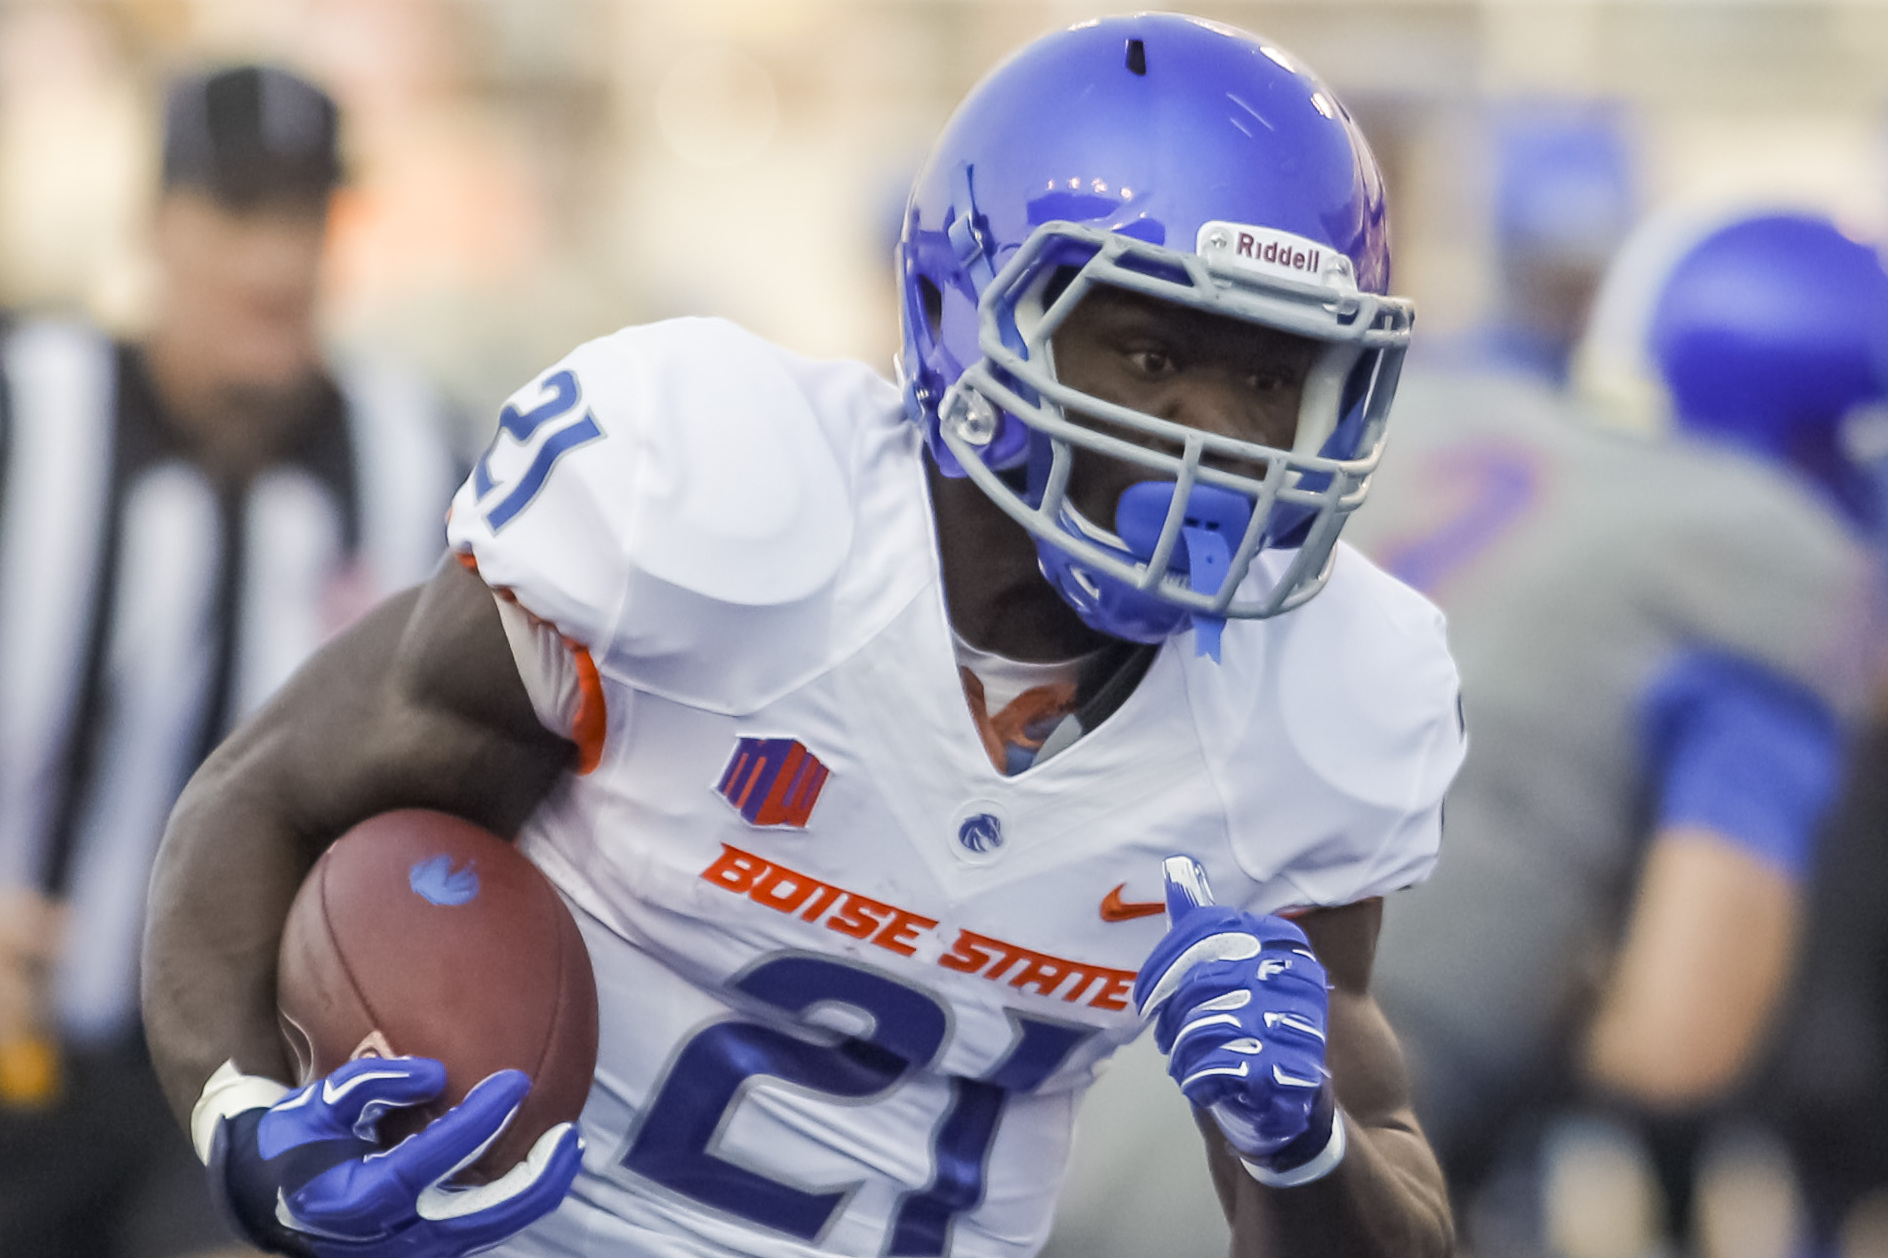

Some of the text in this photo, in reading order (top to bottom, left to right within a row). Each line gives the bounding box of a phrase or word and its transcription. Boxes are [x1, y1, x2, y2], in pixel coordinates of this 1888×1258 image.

[1236, 231, 1320, 273] Riddell
[468, 368, 608, 538] 21
[701, 843, 1138, 1010] BOISE STATE
[604, 948, 1103, 1258] 21
